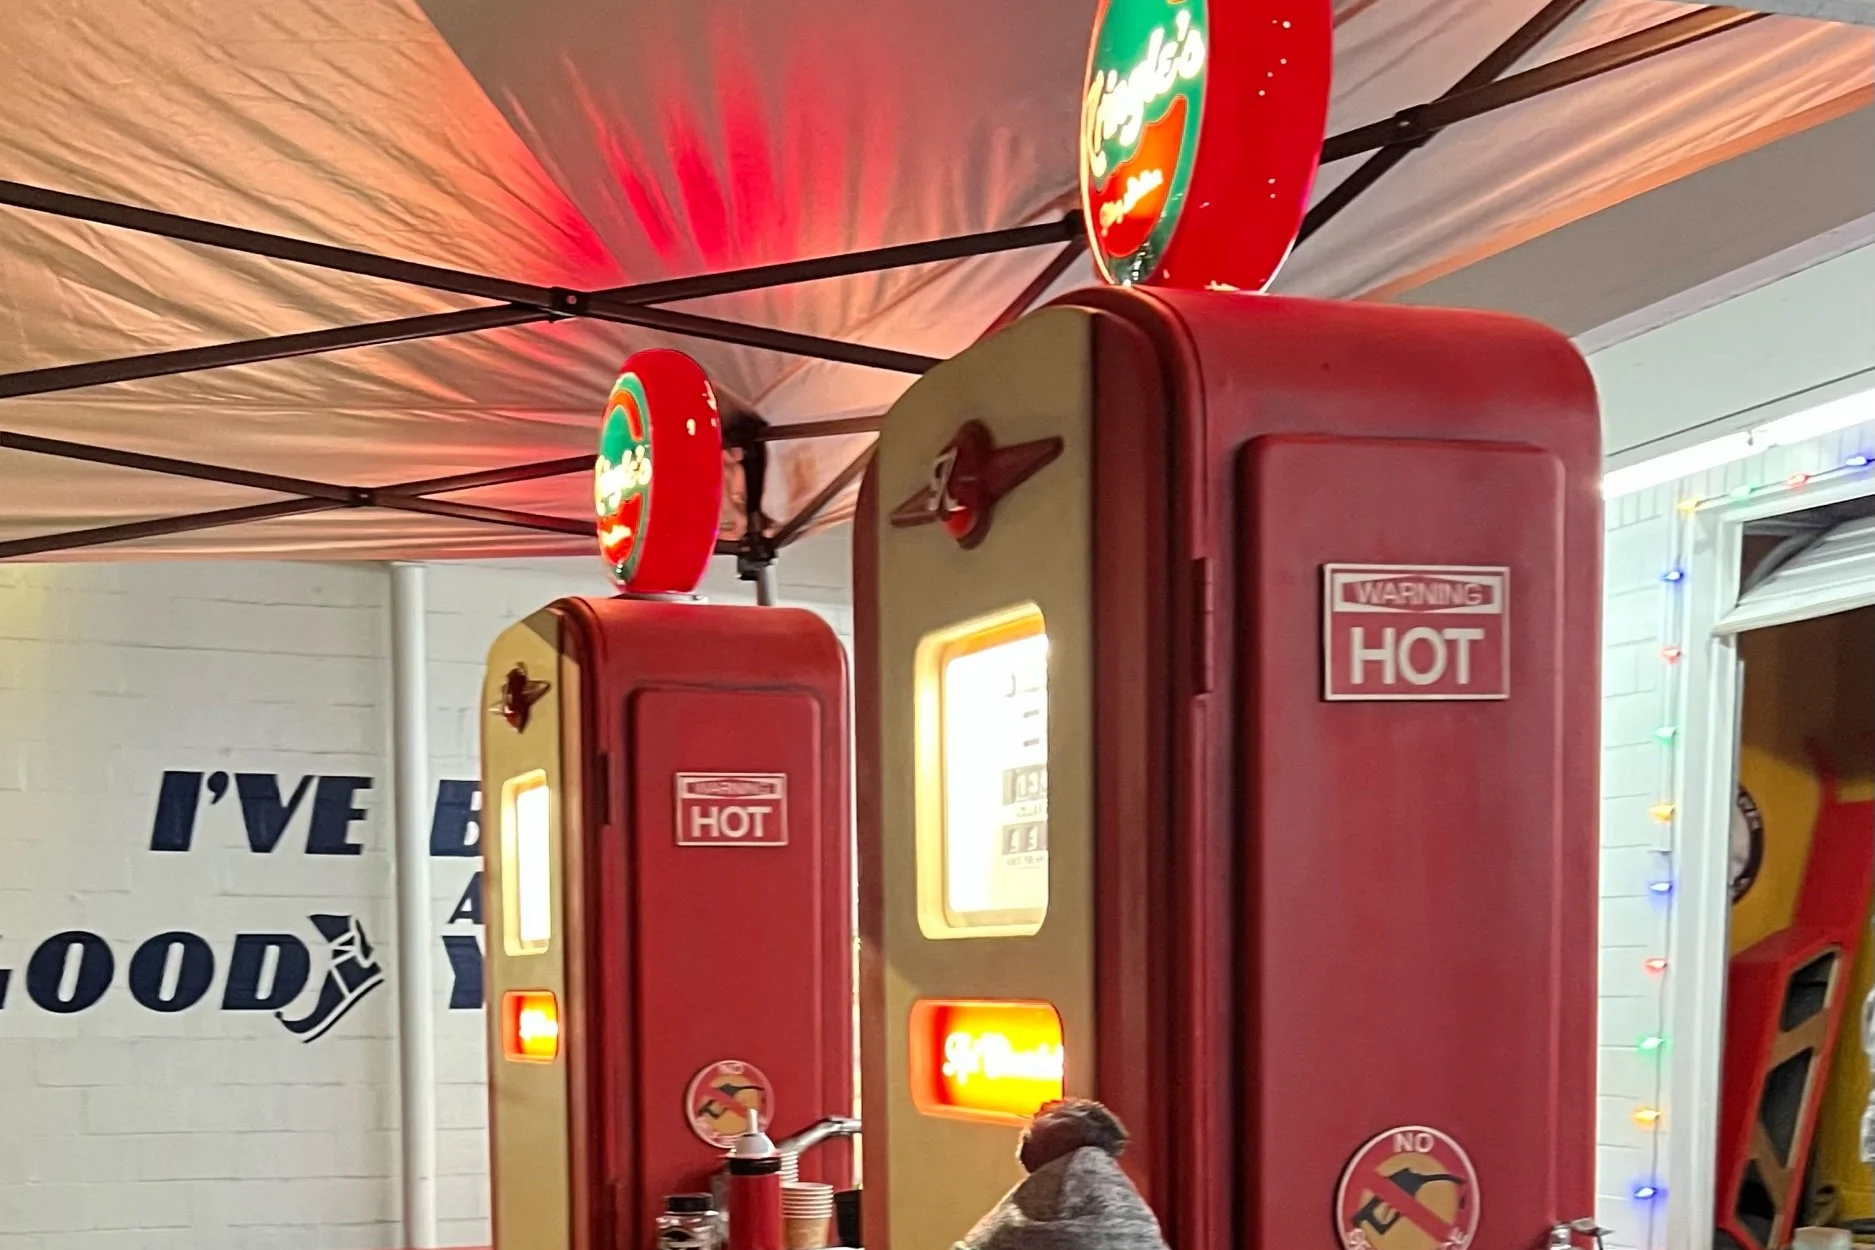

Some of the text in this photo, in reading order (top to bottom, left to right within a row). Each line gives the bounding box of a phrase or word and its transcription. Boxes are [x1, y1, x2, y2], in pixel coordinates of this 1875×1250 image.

[1357, 583, 1483, 605] WARNING
[1351, 627, 1485, 686] HOT
[150, 771, 374, 855] I'VE
[690, 806, 773, 837] HOT
[0, 931, 311, 1013] OOD
[1394, 1132, 1434, 1153] NO
